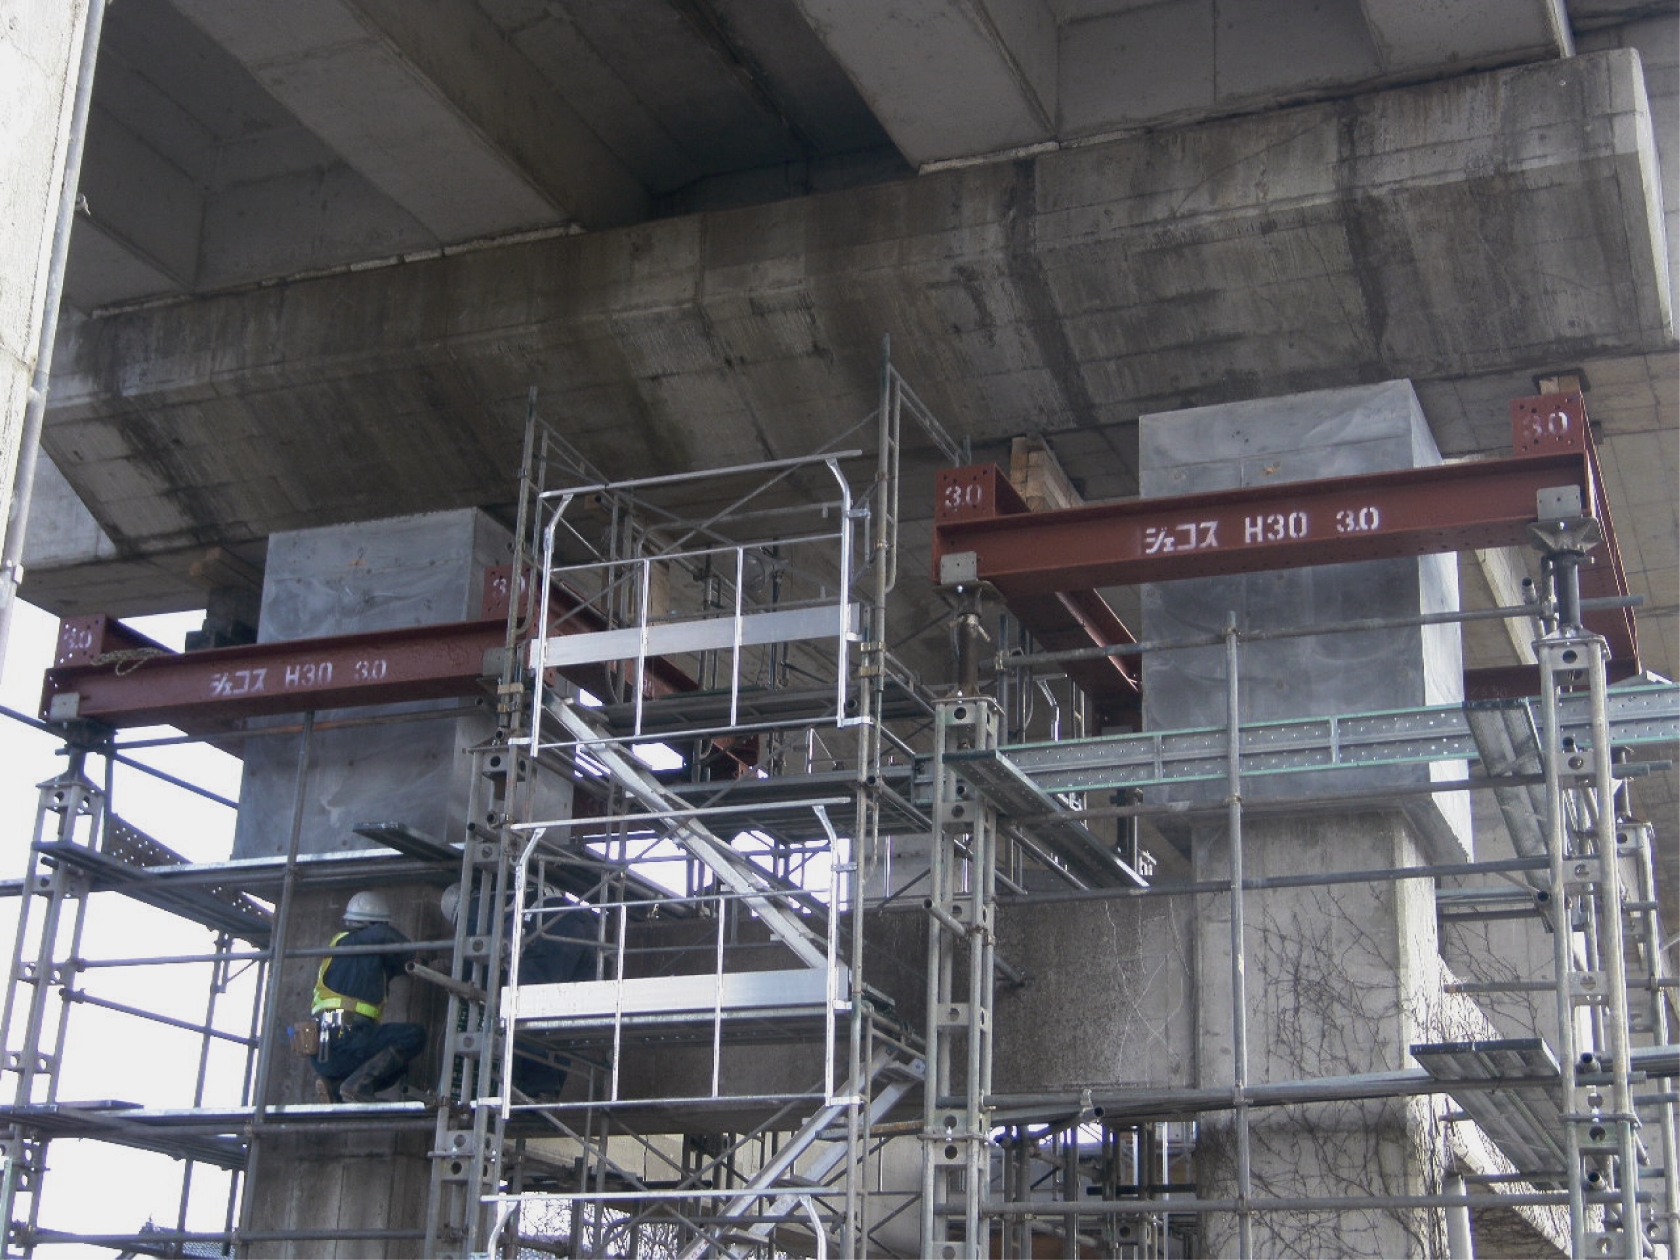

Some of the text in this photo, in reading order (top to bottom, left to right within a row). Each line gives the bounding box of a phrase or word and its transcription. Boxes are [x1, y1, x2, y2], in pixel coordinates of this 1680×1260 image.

[1145, 506, 1379, 554] ジェコス H30 3.0
[285, 662, 333, 689] H30
